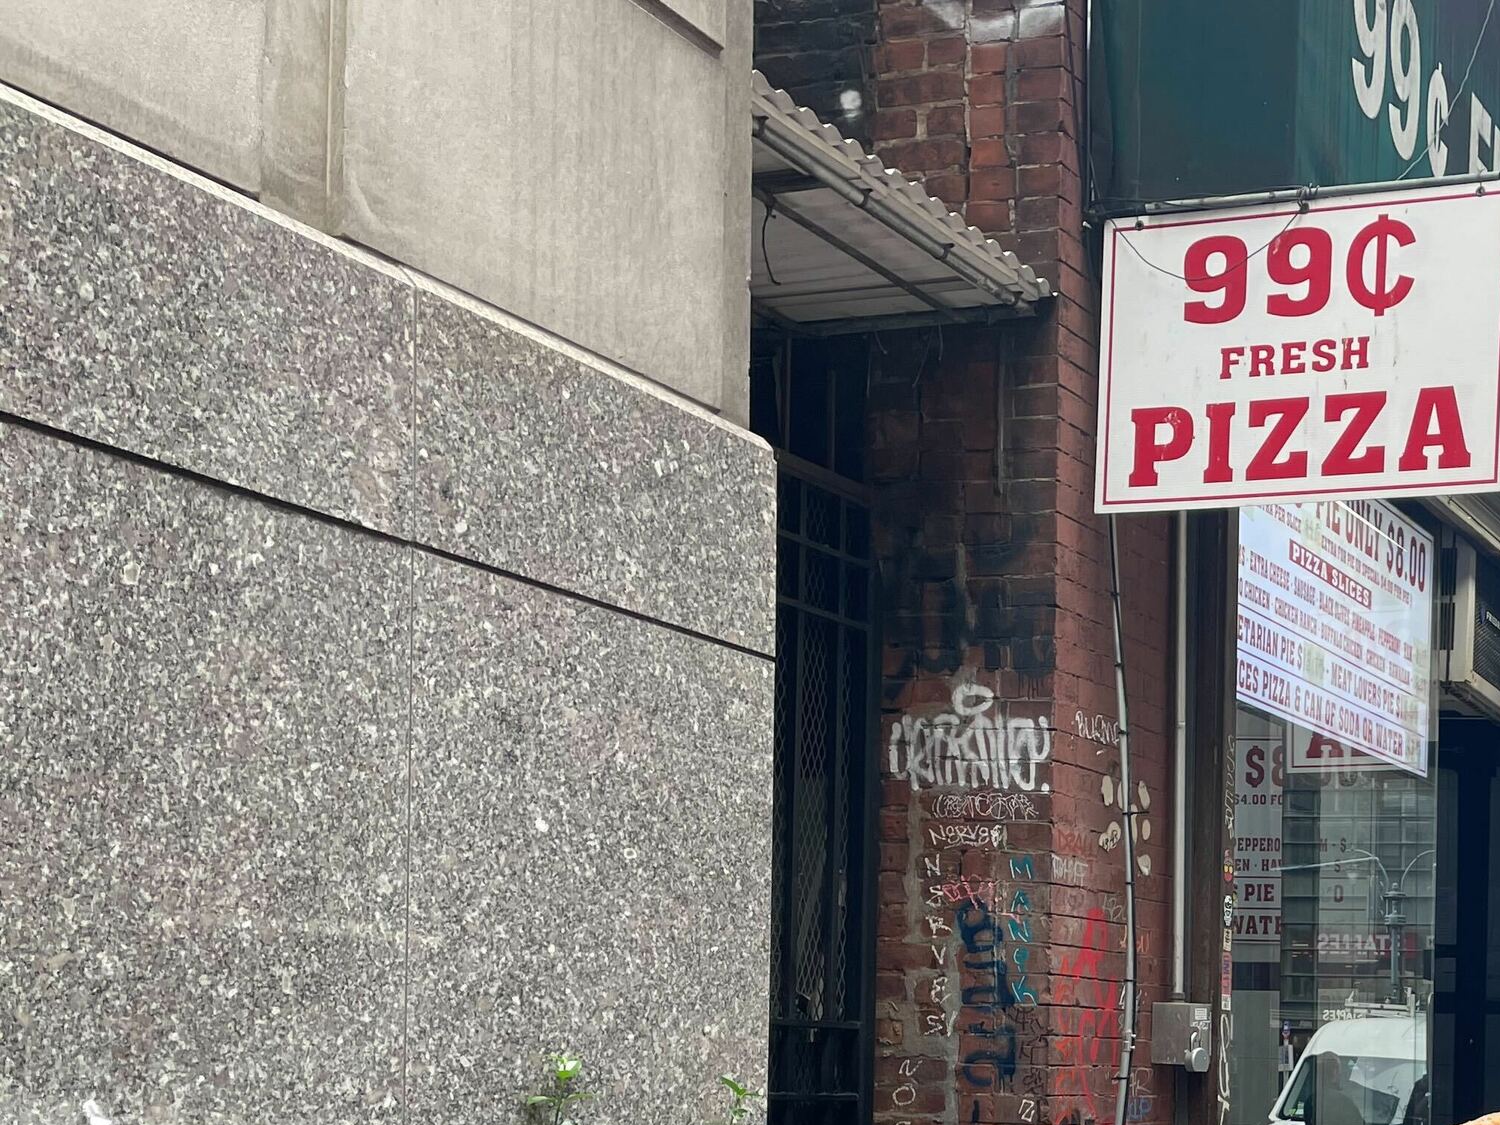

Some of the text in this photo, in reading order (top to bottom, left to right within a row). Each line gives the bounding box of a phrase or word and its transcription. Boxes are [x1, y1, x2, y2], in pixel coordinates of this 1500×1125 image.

[1352, 0, 1450, 177] 99¢
[1183, 214, 1416, 325] 99¢
[1219, 335, 1369, 380] FRESH
[1128, 386, 1472, 488] PIZZA
[1292, 544, 1328, 583] PIZZA
[1331, 567, 1370, 607] SLICES
[1386, 519, 1426, 592] $8.00
[1281, 635, 1295, 666] PIE
[1331, 662, 1352, 693] MEAT
[1354, 674, 1382, 709] LOVERS
[1262, 669, 1291, 707] PIZZA
[1304, 690, 1322, 722] CAN
[1325, 699, 1336, 727] OF
[1338, 706, 1360, 738] SODA
[1362, 718, 1373, 743] OR
[1376, 724, 1403, 757] WATER
[1244, 883, 1275, 902] PIE
